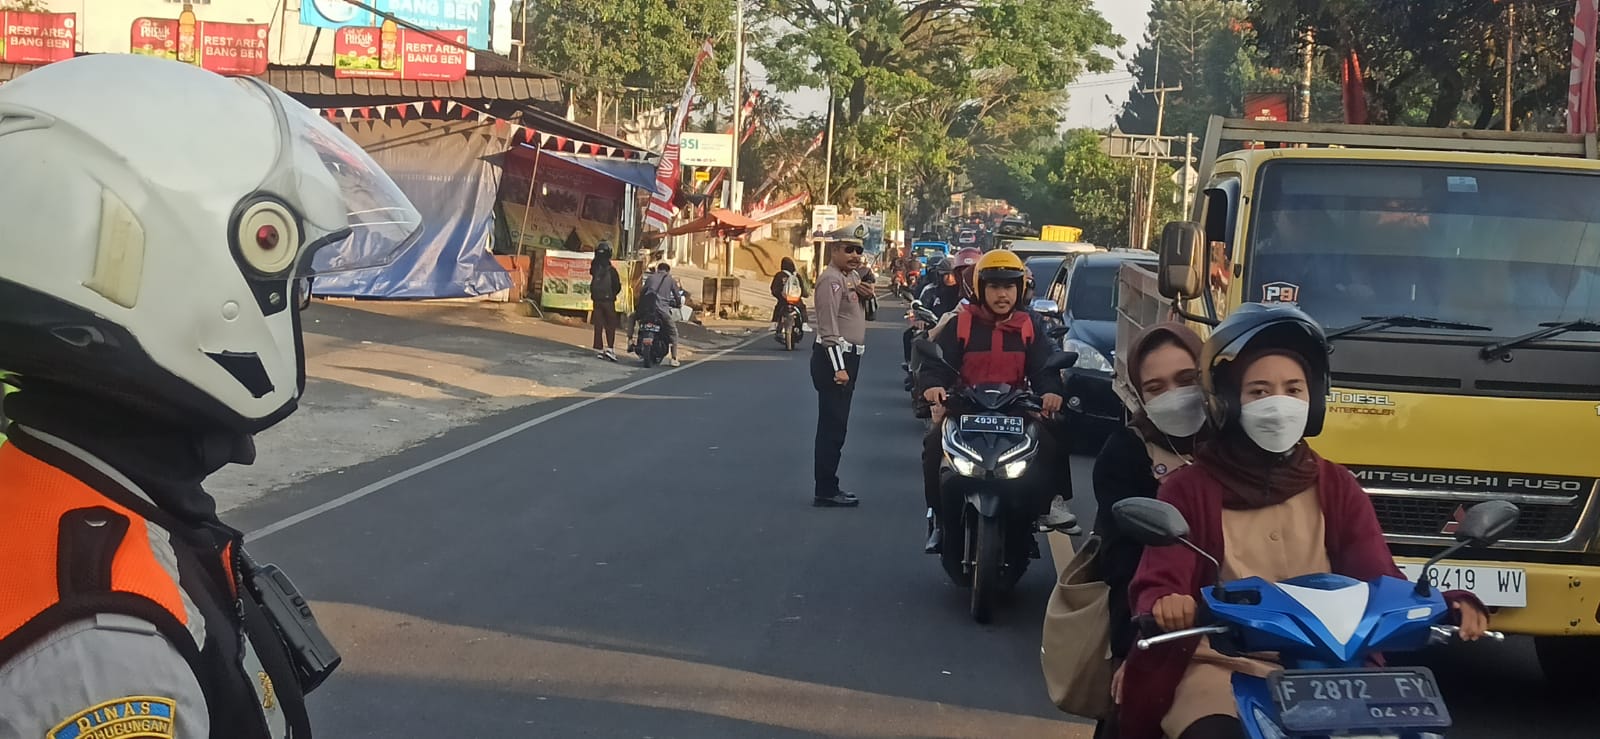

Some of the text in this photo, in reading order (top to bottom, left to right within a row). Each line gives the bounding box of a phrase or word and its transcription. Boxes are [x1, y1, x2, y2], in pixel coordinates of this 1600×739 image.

[444, 1, 479, 22] BEN
[8, 25, 73, 39] REST AREA
[10, 36, 70, 48] BANG BEN
[204, 35, 265, 49] REST AREA
[405, 42, 465, 55] REST AREA
[206, 46, 263, 59] BANG BEN
[407, 52, 462, 64] BANG BEN
[680, 138, 699, 149] BSI
[1266, 286, 1293, 302] P9
[1341, 393, 1395, 406] DIESEL
[1329, 406, 1395, 416] INTERCOOLER
[963, 416, 969, 424] F
[1348, 470, 1581, 491] MITSUBISHI FUSO
[1429, 567, 1522, 593] 8419 WV
[1281, 677, 1427, 701] F 2872 FY
[77, 701, 151, 733] DINAS
